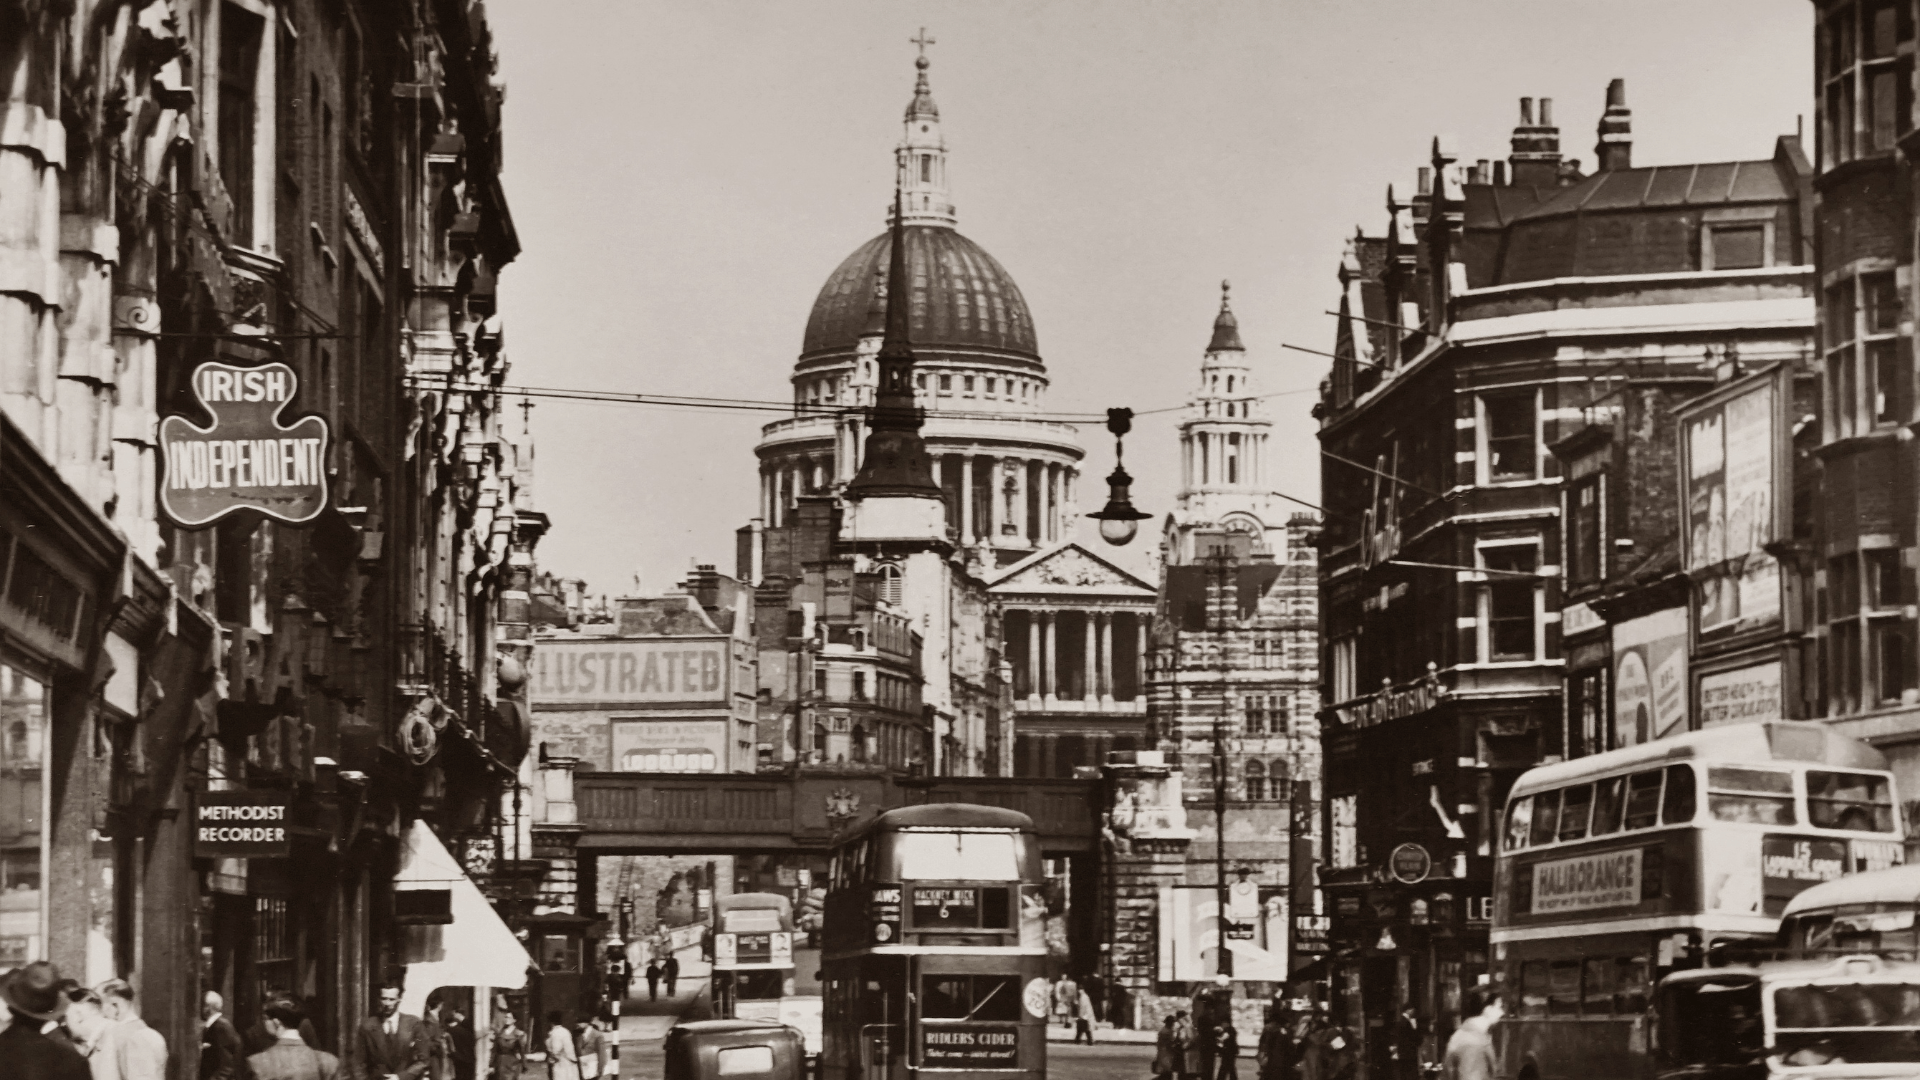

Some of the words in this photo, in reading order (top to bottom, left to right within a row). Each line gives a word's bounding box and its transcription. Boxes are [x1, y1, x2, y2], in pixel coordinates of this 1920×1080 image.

[203, 371, 286, 402] IRISH
[169, 439, 321, 490] INDEPENDENT
[199, 805, 285, 820] METHODIST
[199, 827, 285, 842] RECORDER
[1793, 841, 1811, 860] 15
[1538, 855, 1634, 896] HALIBORANGE
[914, 889, 951, 900] HACKNEY
[953, 889, 975, 900] WICK
[939, 903, 949, 919] 6
[926, 1032, 975, 1045] RIDLERS
[978, 1033, 1015, 1046] CIDER
